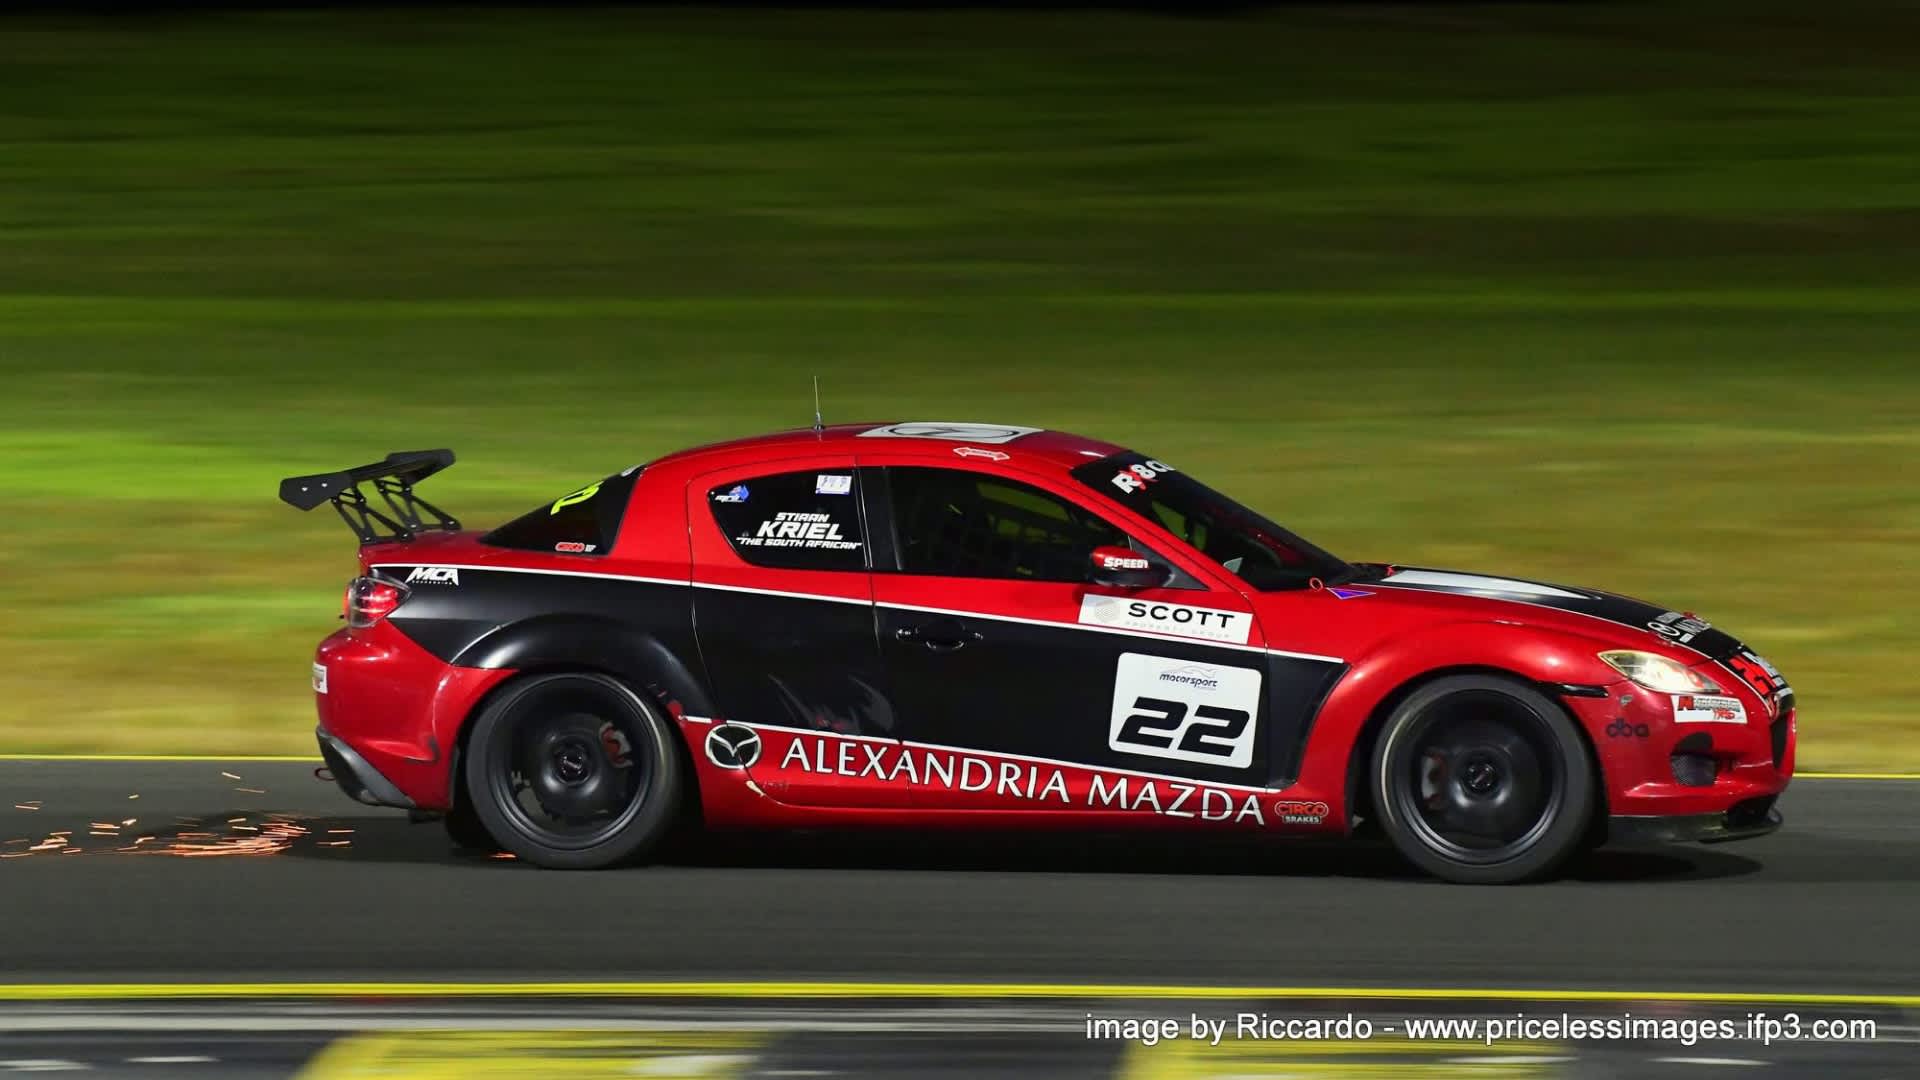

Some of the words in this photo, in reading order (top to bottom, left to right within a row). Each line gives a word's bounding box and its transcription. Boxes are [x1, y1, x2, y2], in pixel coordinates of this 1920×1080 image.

[757, 521, 843, 540] KRIEL
[764, 539, 804, 548] SOUTH
[405, 567, 459, 586] MCA
[1128, 603, 1235, 629] SCOTT
[1160, 674, 1218, 689] motorsport
[1116, 696, 1250, 757] 22
[1606, 717, 1649, 738] dba
[781, 737, 1070, 802] ALEXANDRIA
[1088, 775, 1264, 826] MAZDA
